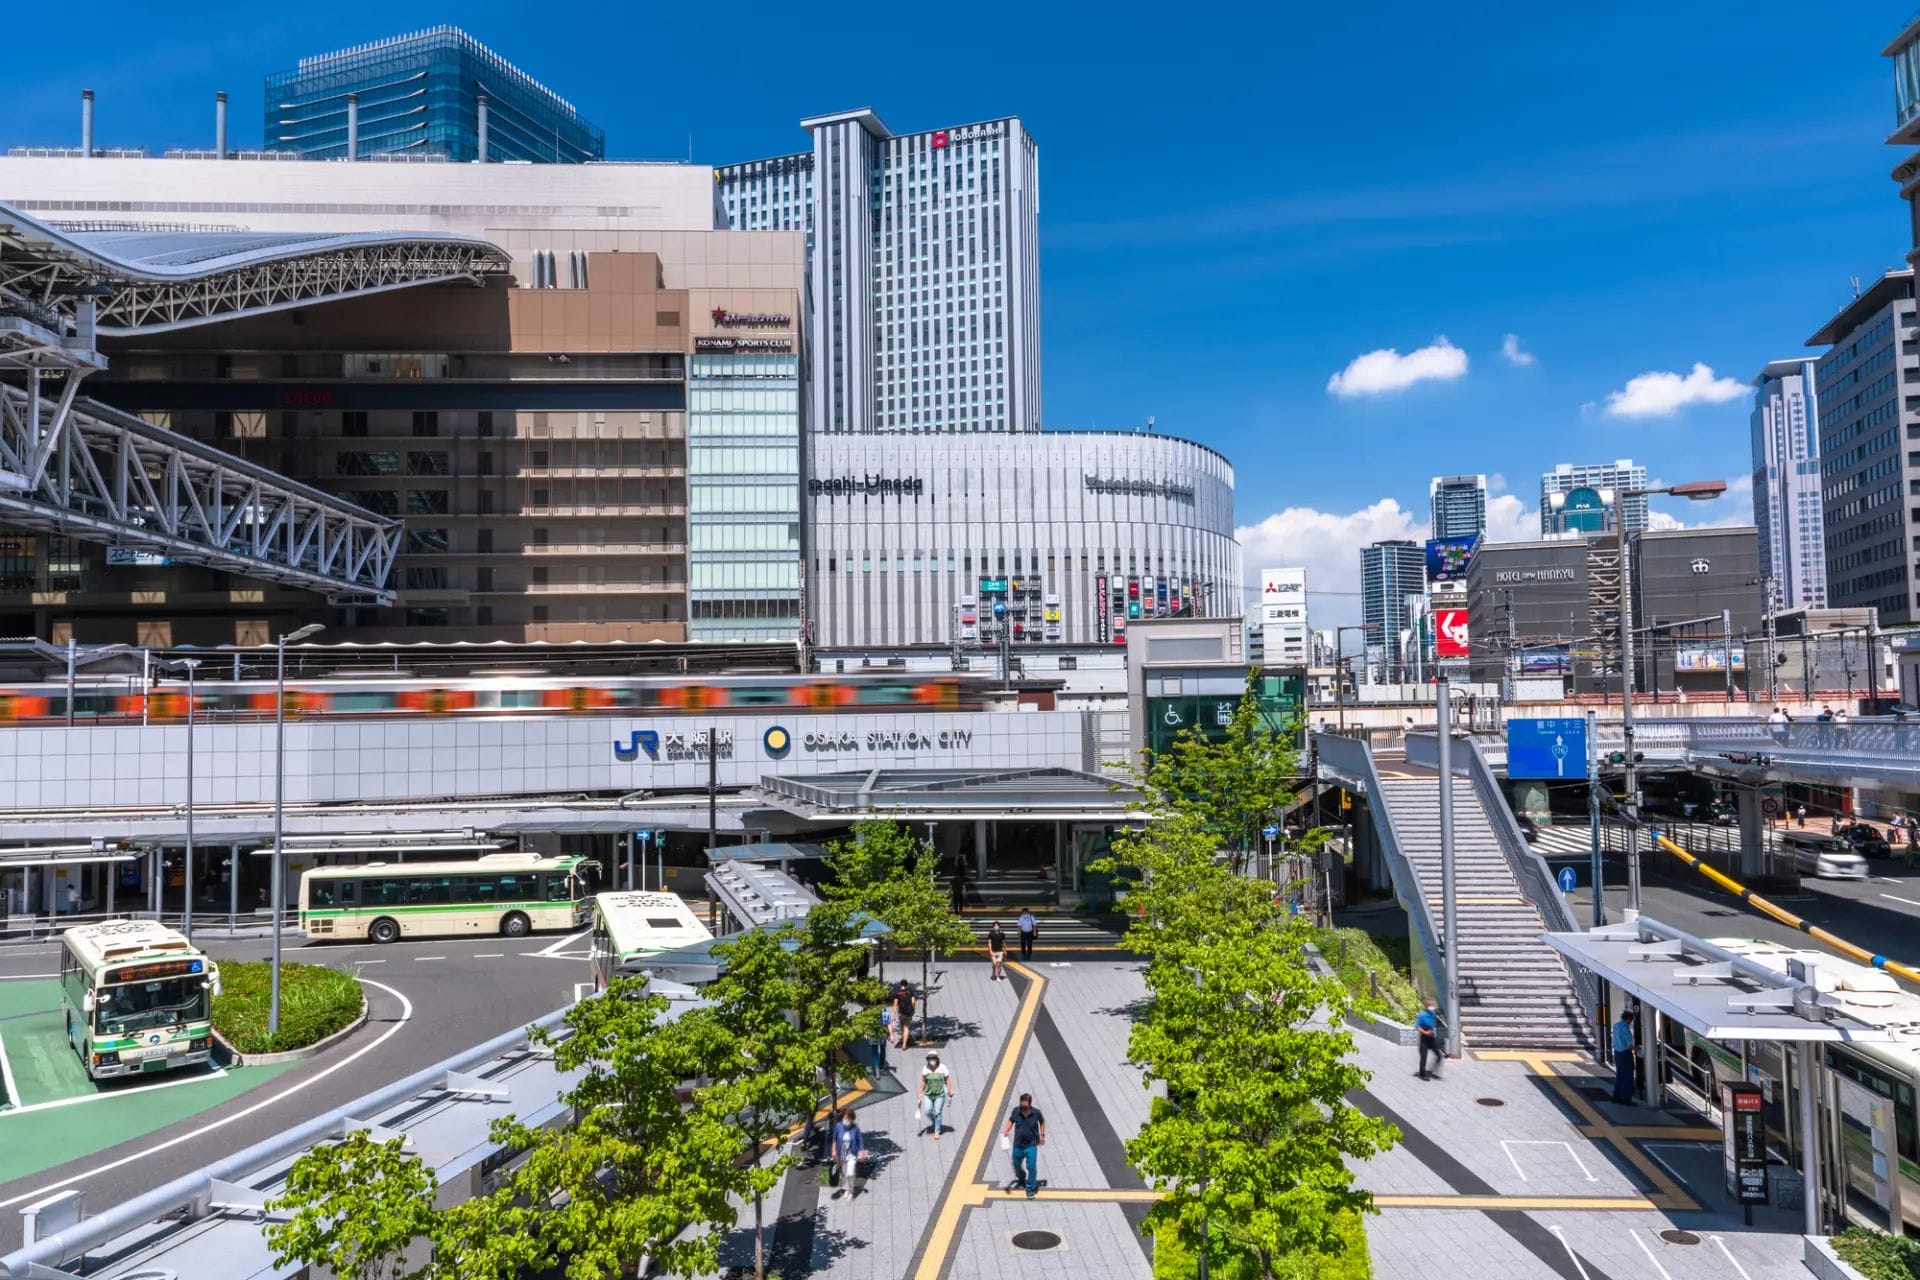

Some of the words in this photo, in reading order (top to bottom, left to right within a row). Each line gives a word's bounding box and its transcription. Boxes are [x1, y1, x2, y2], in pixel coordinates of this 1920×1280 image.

[1496, 571, 1520, 581] HOTEL
[1537, 568, 1574, 580] HANKYU
[614, 731, 659, 760] JR
[664, 730, 732, 745] 大阪駅
[804, 731, 857, 748] OSAKA
[867, 730, 932, 747] STATION
[938, 728, 972, 746] CITY
